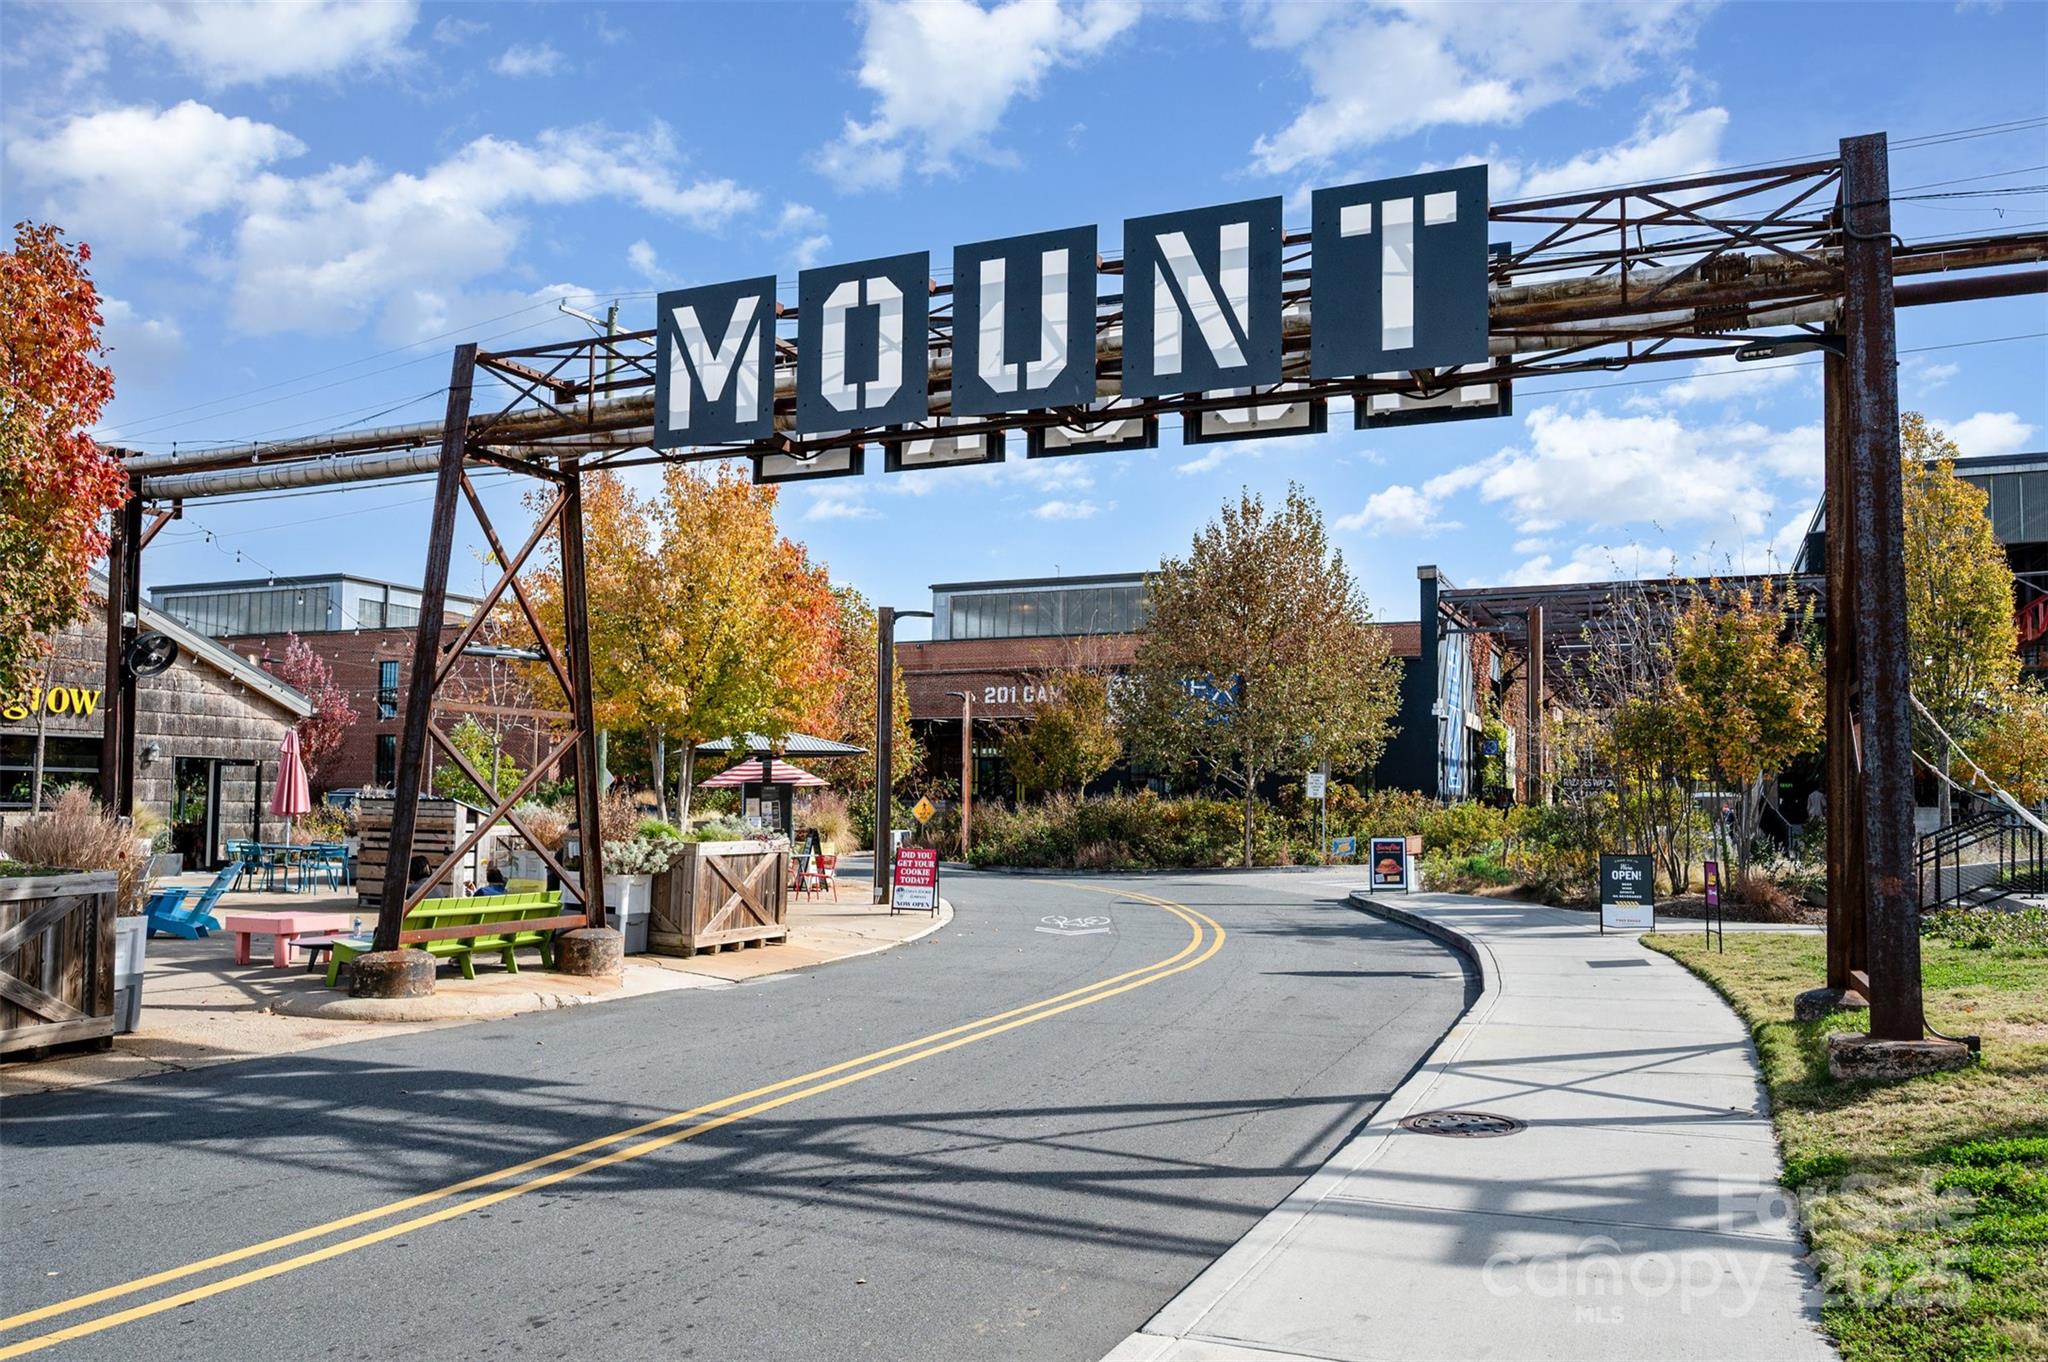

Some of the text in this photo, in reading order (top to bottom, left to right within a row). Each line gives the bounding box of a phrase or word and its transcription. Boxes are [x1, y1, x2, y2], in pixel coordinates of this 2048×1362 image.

[668, 190, 1458, 431] MOUNT
[984, 686, 1016, 704] 201
[901, 851, 933, 860] DID YOU
[914, 860, 935, 868] YOUR
[900, 868, 931, 876] COOKIE
[1611, 870, 1642, 880] OPEN!
[900, 876, 930, 885] TODAY?
